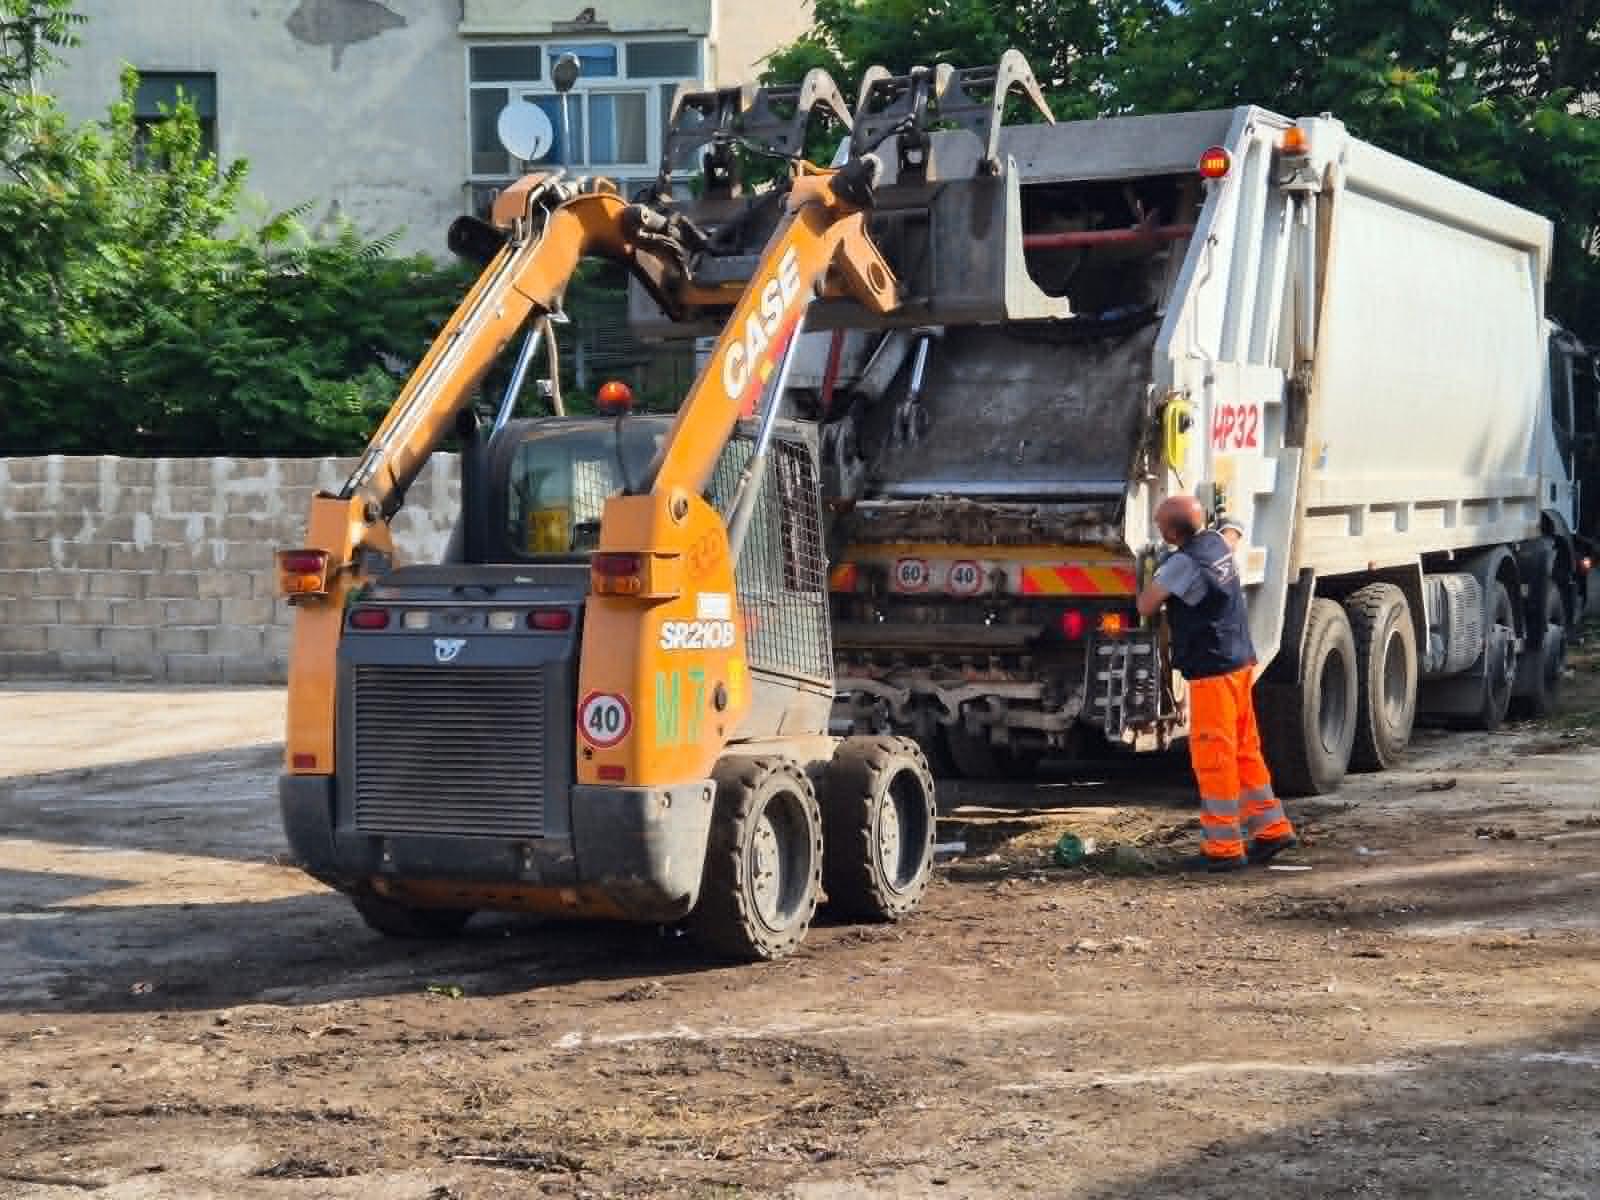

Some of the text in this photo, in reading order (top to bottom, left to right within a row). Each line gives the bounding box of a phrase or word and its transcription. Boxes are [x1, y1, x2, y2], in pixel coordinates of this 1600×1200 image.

[723, 246, 800, 400] CASE
[954, 566, 975, 584] 40
[589, 704, 620, 734] 40
